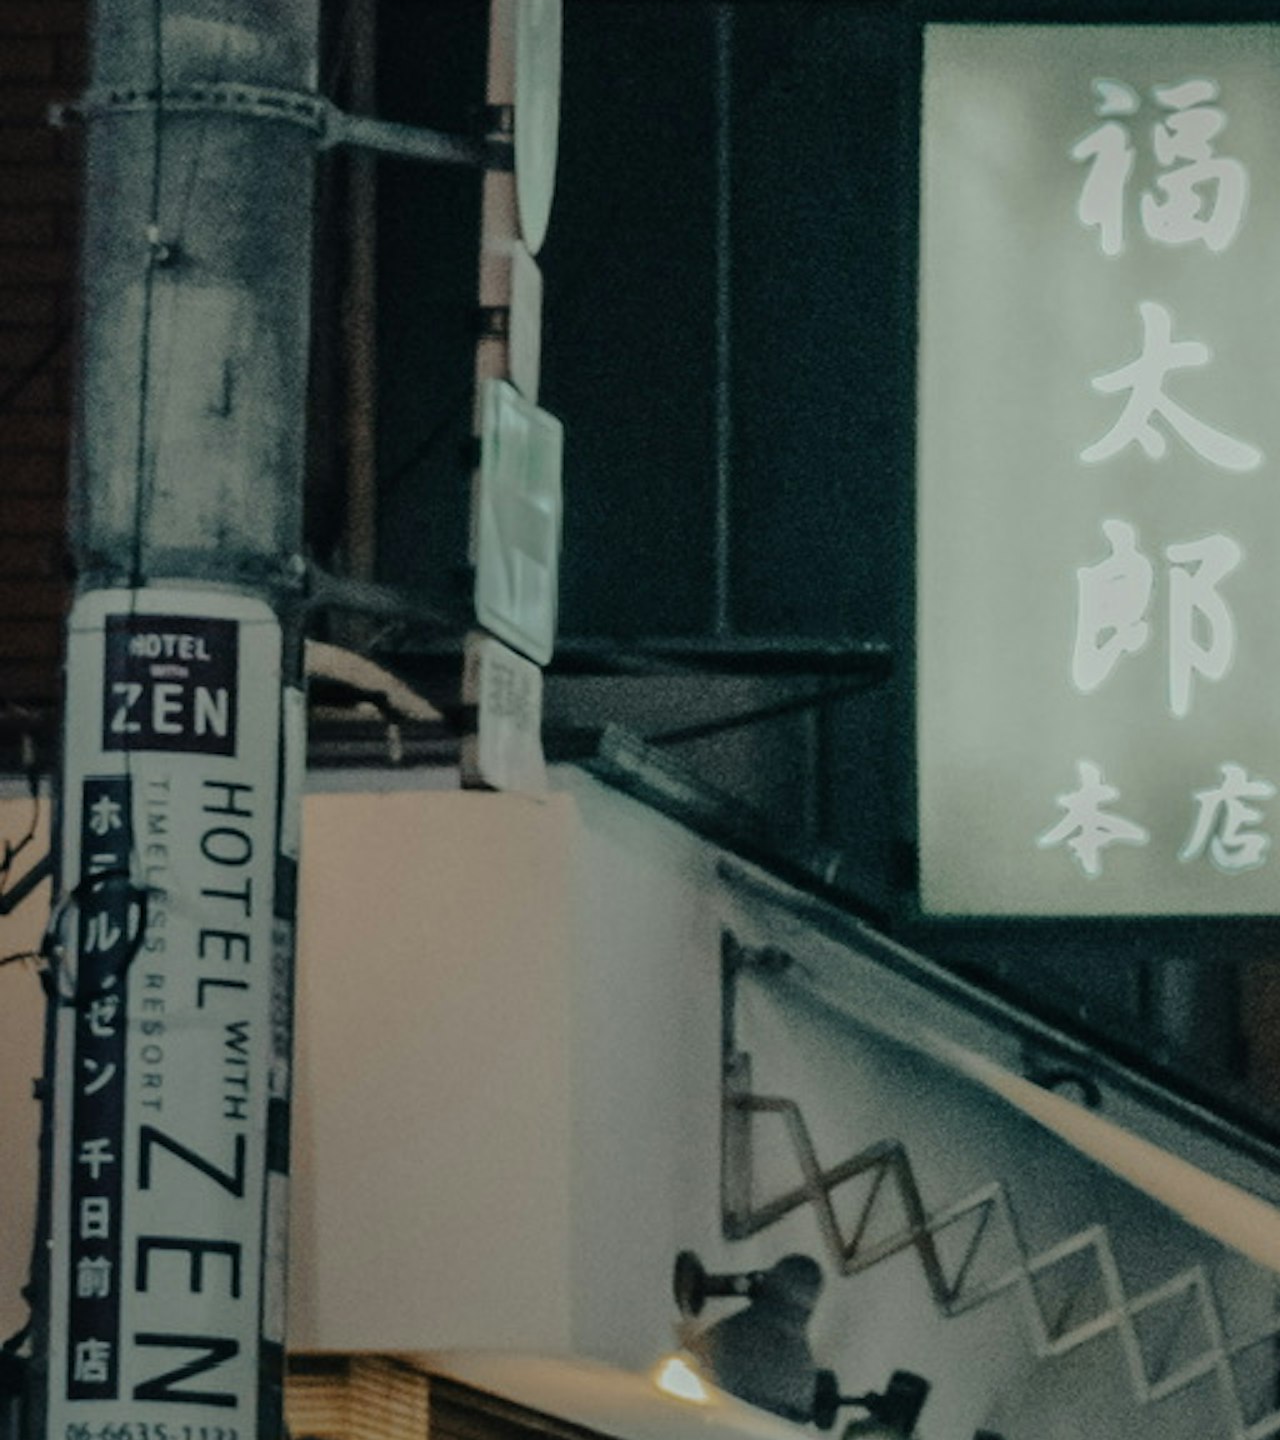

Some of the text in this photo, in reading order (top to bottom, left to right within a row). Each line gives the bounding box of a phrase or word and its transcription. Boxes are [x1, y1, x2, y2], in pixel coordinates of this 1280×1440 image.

[1071, 77, 1264, 720] 福太郎
[109, 681, 230, 738] ZEN
[128, 631, 212, 663] HOTEL
[1037, 762, 1276, 879] 本店
[139, 779, 171, 1112] TIMELESS RESORT
[131, 779, 255, 1409] HOTEL WITH ZEN
